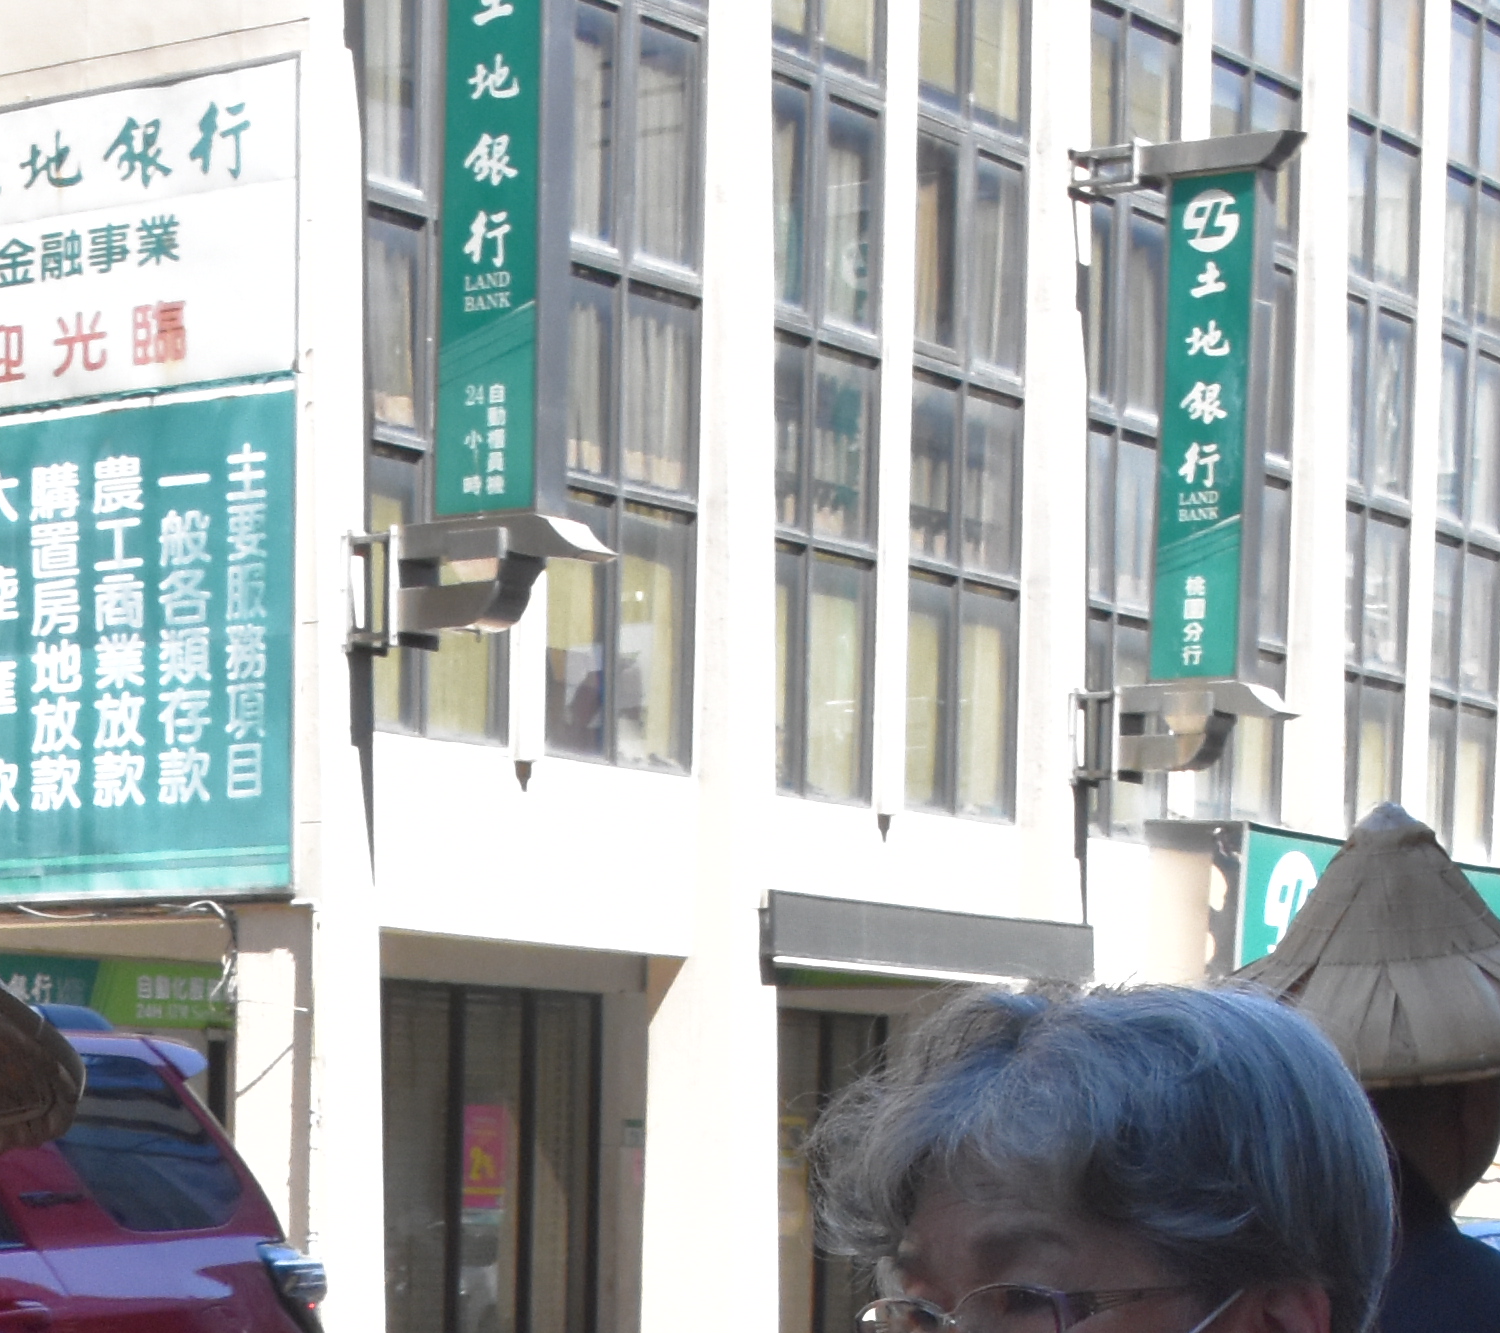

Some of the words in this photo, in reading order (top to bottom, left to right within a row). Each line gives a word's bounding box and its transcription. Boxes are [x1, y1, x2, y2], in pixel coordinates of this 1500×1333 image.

[464, 271, 511, 292] LAND
[464, 291, 511, 312] BANK
[1178, 262, 1230, 489] 土地銀行
[1178, 490, 1220, 506] LAND
[1178, 505, 1219, 522] BANK
[29, 461, 81, 812] 購置房地放款
[93, 455, 146, 808] 農工商業放款
[158, 471, 213, 805] 一般各類存款
[226, 443, 267, 799] 主要服務項目
